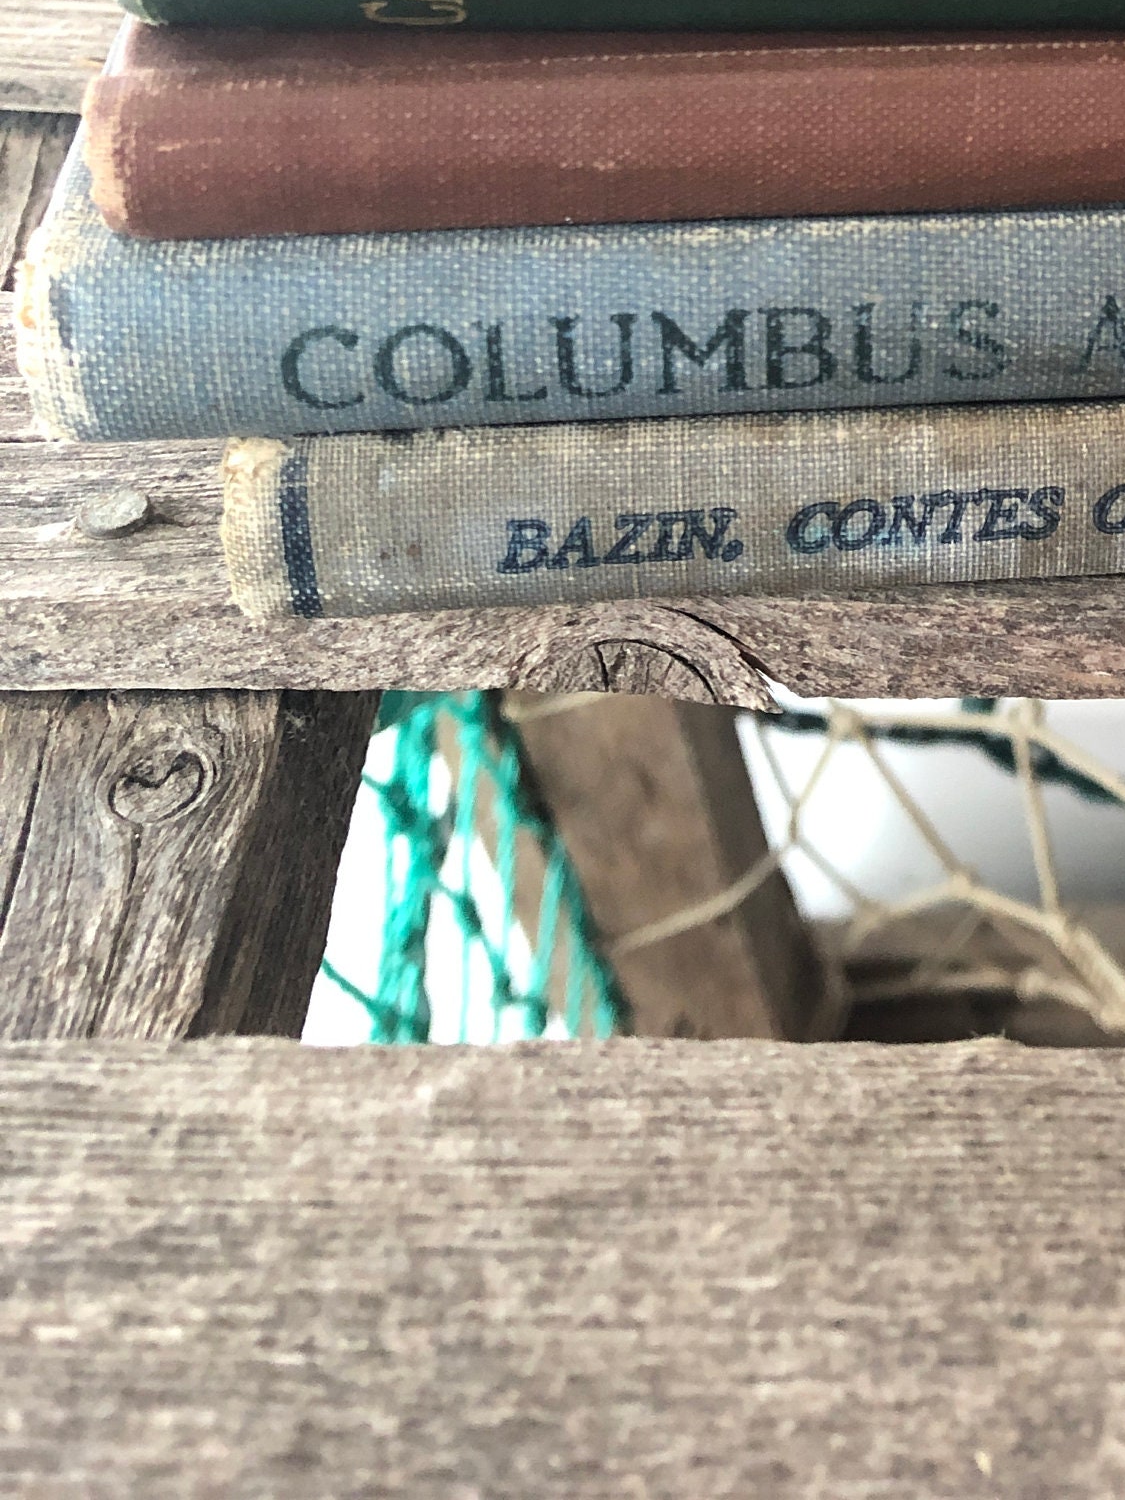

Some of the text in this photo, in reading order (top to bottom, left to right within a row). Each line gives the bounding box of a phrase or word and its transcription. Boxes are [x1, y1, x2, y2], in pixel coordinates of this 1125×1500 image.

[279, 295, 1014, 412] COLUMBUS
[496, 505, 746, 576] BAZIN.
[785, 484, 1064, 557] CONTES
